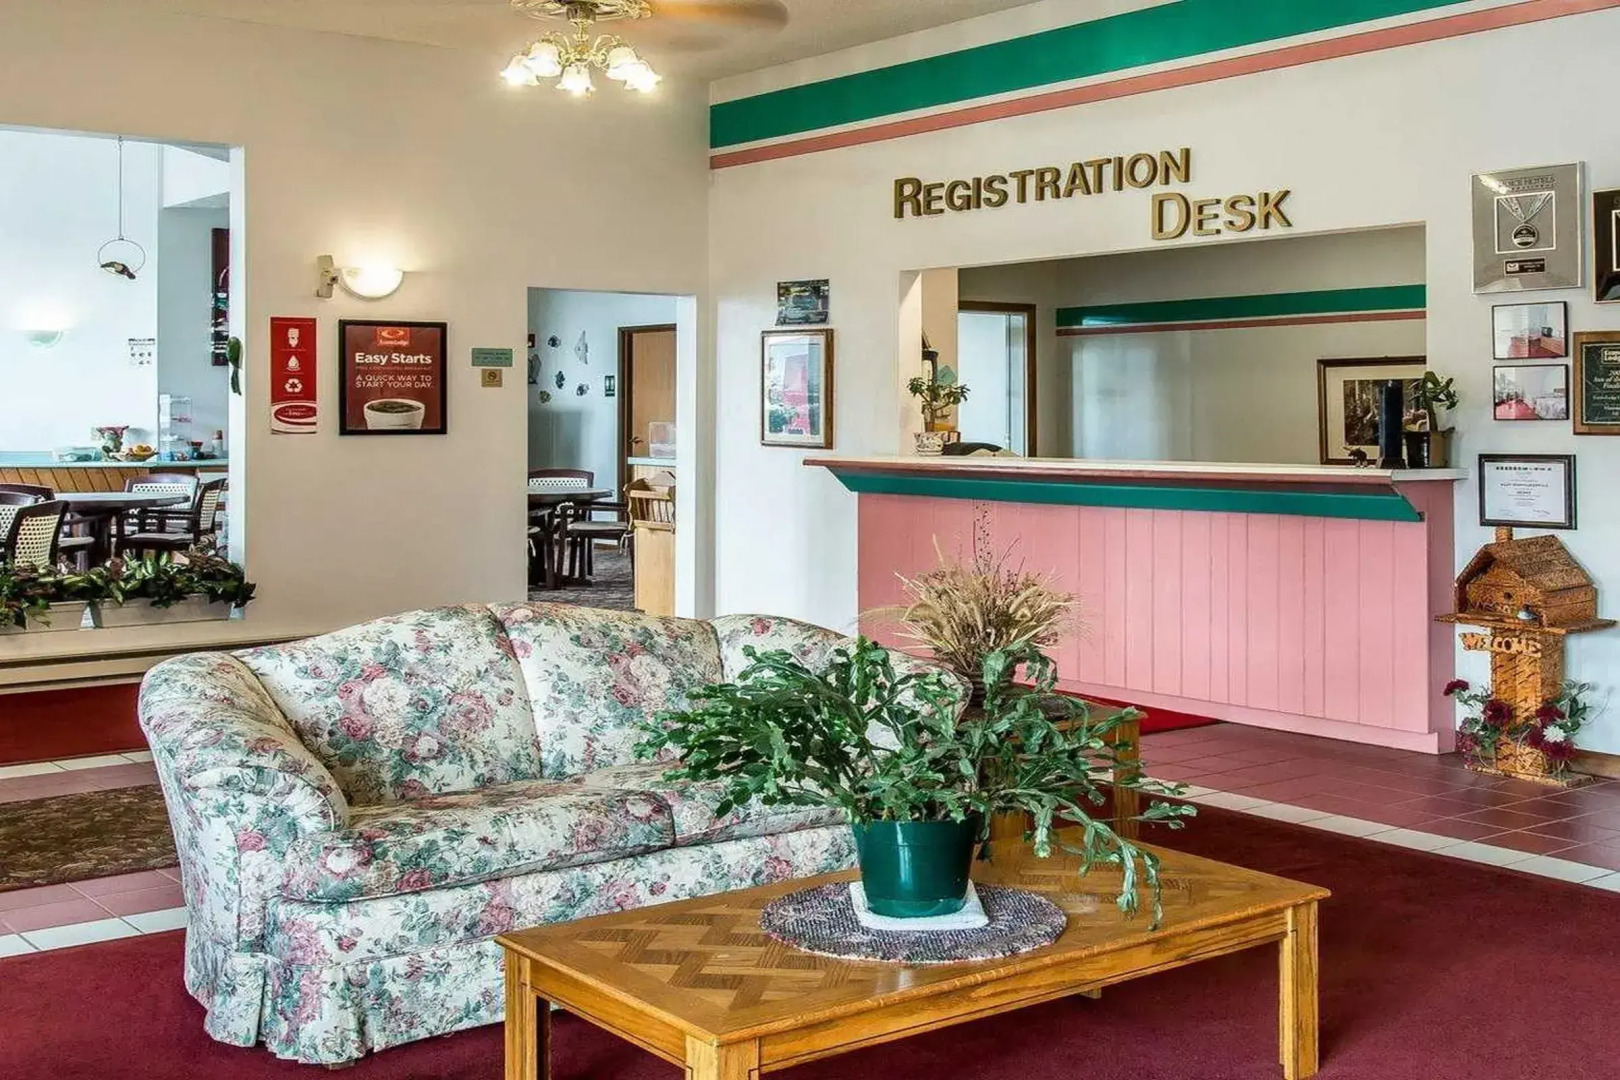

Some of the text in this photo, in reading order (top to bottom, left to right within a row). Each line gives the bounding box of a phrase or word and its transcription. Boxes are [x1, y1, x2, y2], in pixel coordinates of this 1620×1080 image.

[893, 147, 1191, 219] REGISTRATION
[1150, 189, 1292, 241] DESK
[355, 352, 432, 365] Easy Starts
[356, 374, 363, 382] A
[365, 374, 395, 382] QUICK
[397, 374, 417, 382] WAY
[355, 381, 384, 389] START
[387, 381, 413, 389] YOUR
